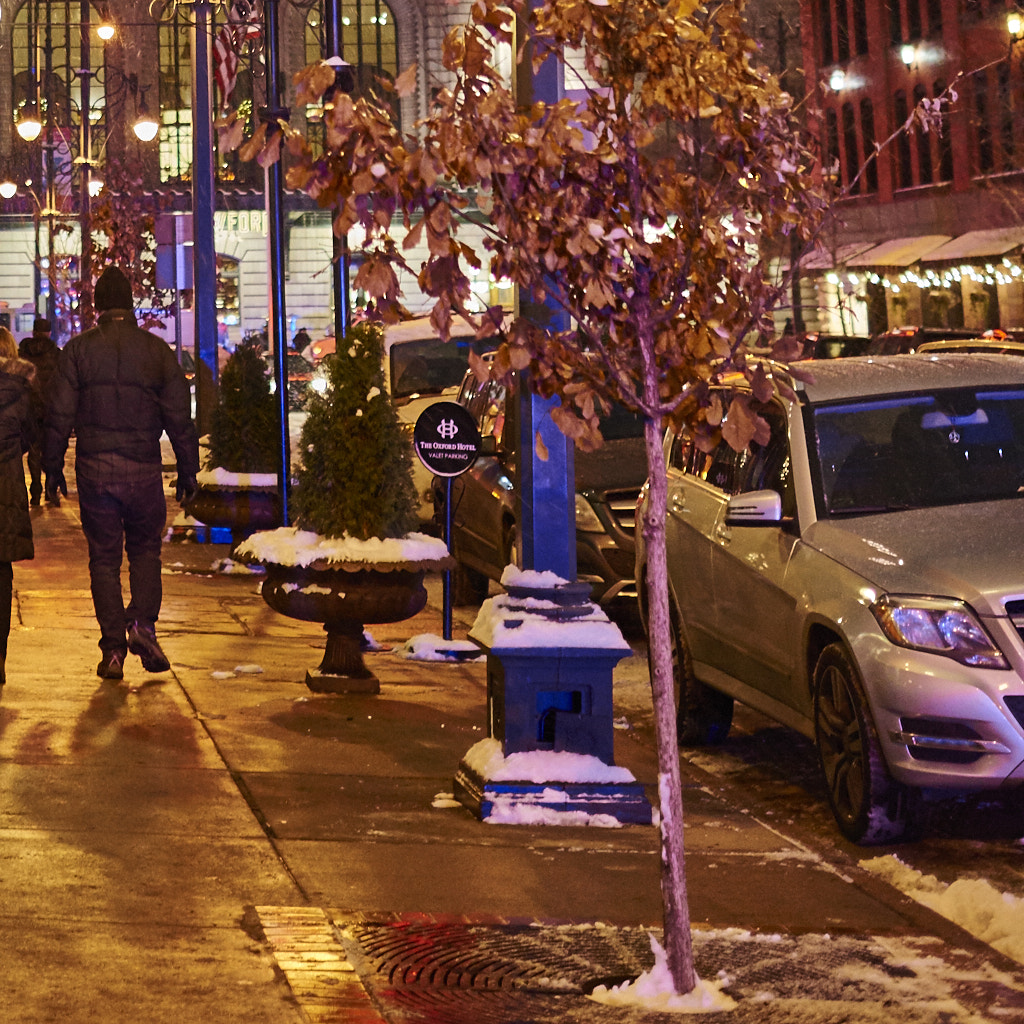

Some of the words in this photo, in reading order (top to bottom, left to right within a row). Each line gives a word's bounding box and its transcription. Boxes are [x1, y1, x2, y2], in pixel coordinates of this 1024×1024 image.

[420, 441, 433, 449] THE
[433, 442, 457, 450] OXFORD
[457, 442, 477, 451] HOTEL
